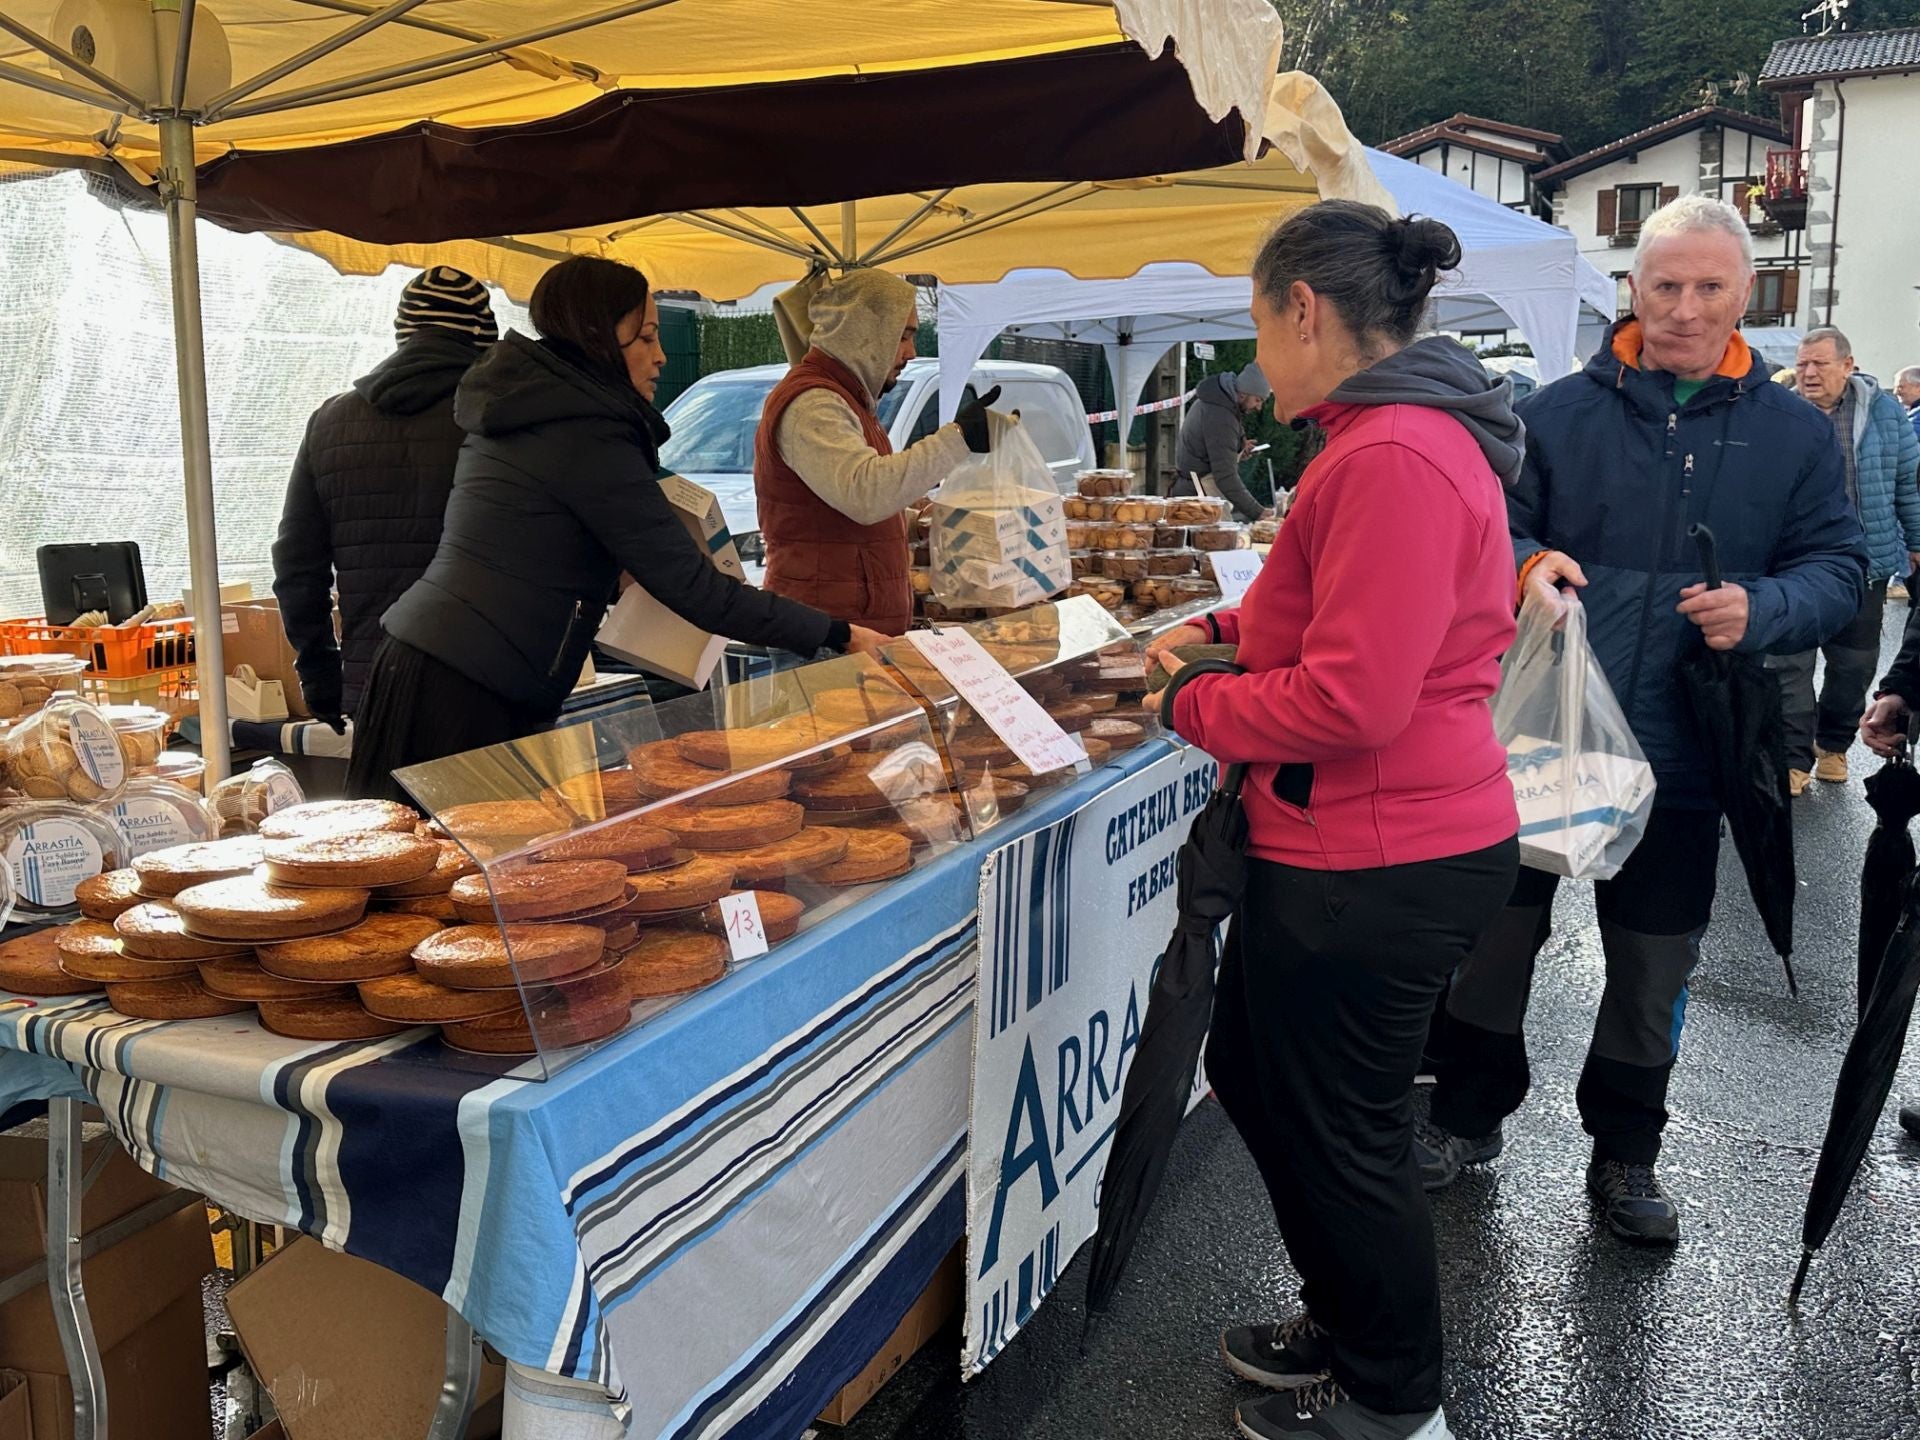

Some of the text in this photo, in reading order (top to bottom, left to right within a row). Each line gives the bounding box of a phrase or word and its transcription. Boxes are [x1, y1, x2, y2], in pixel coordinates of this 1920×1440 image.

[1105, 761, 1218, 866] GATEAUX BASQ
[728, 909, 754, 939] 13
[1127, 850, 1177, 919] FABRI
[978, 953, 1165, 1282] ARRA
